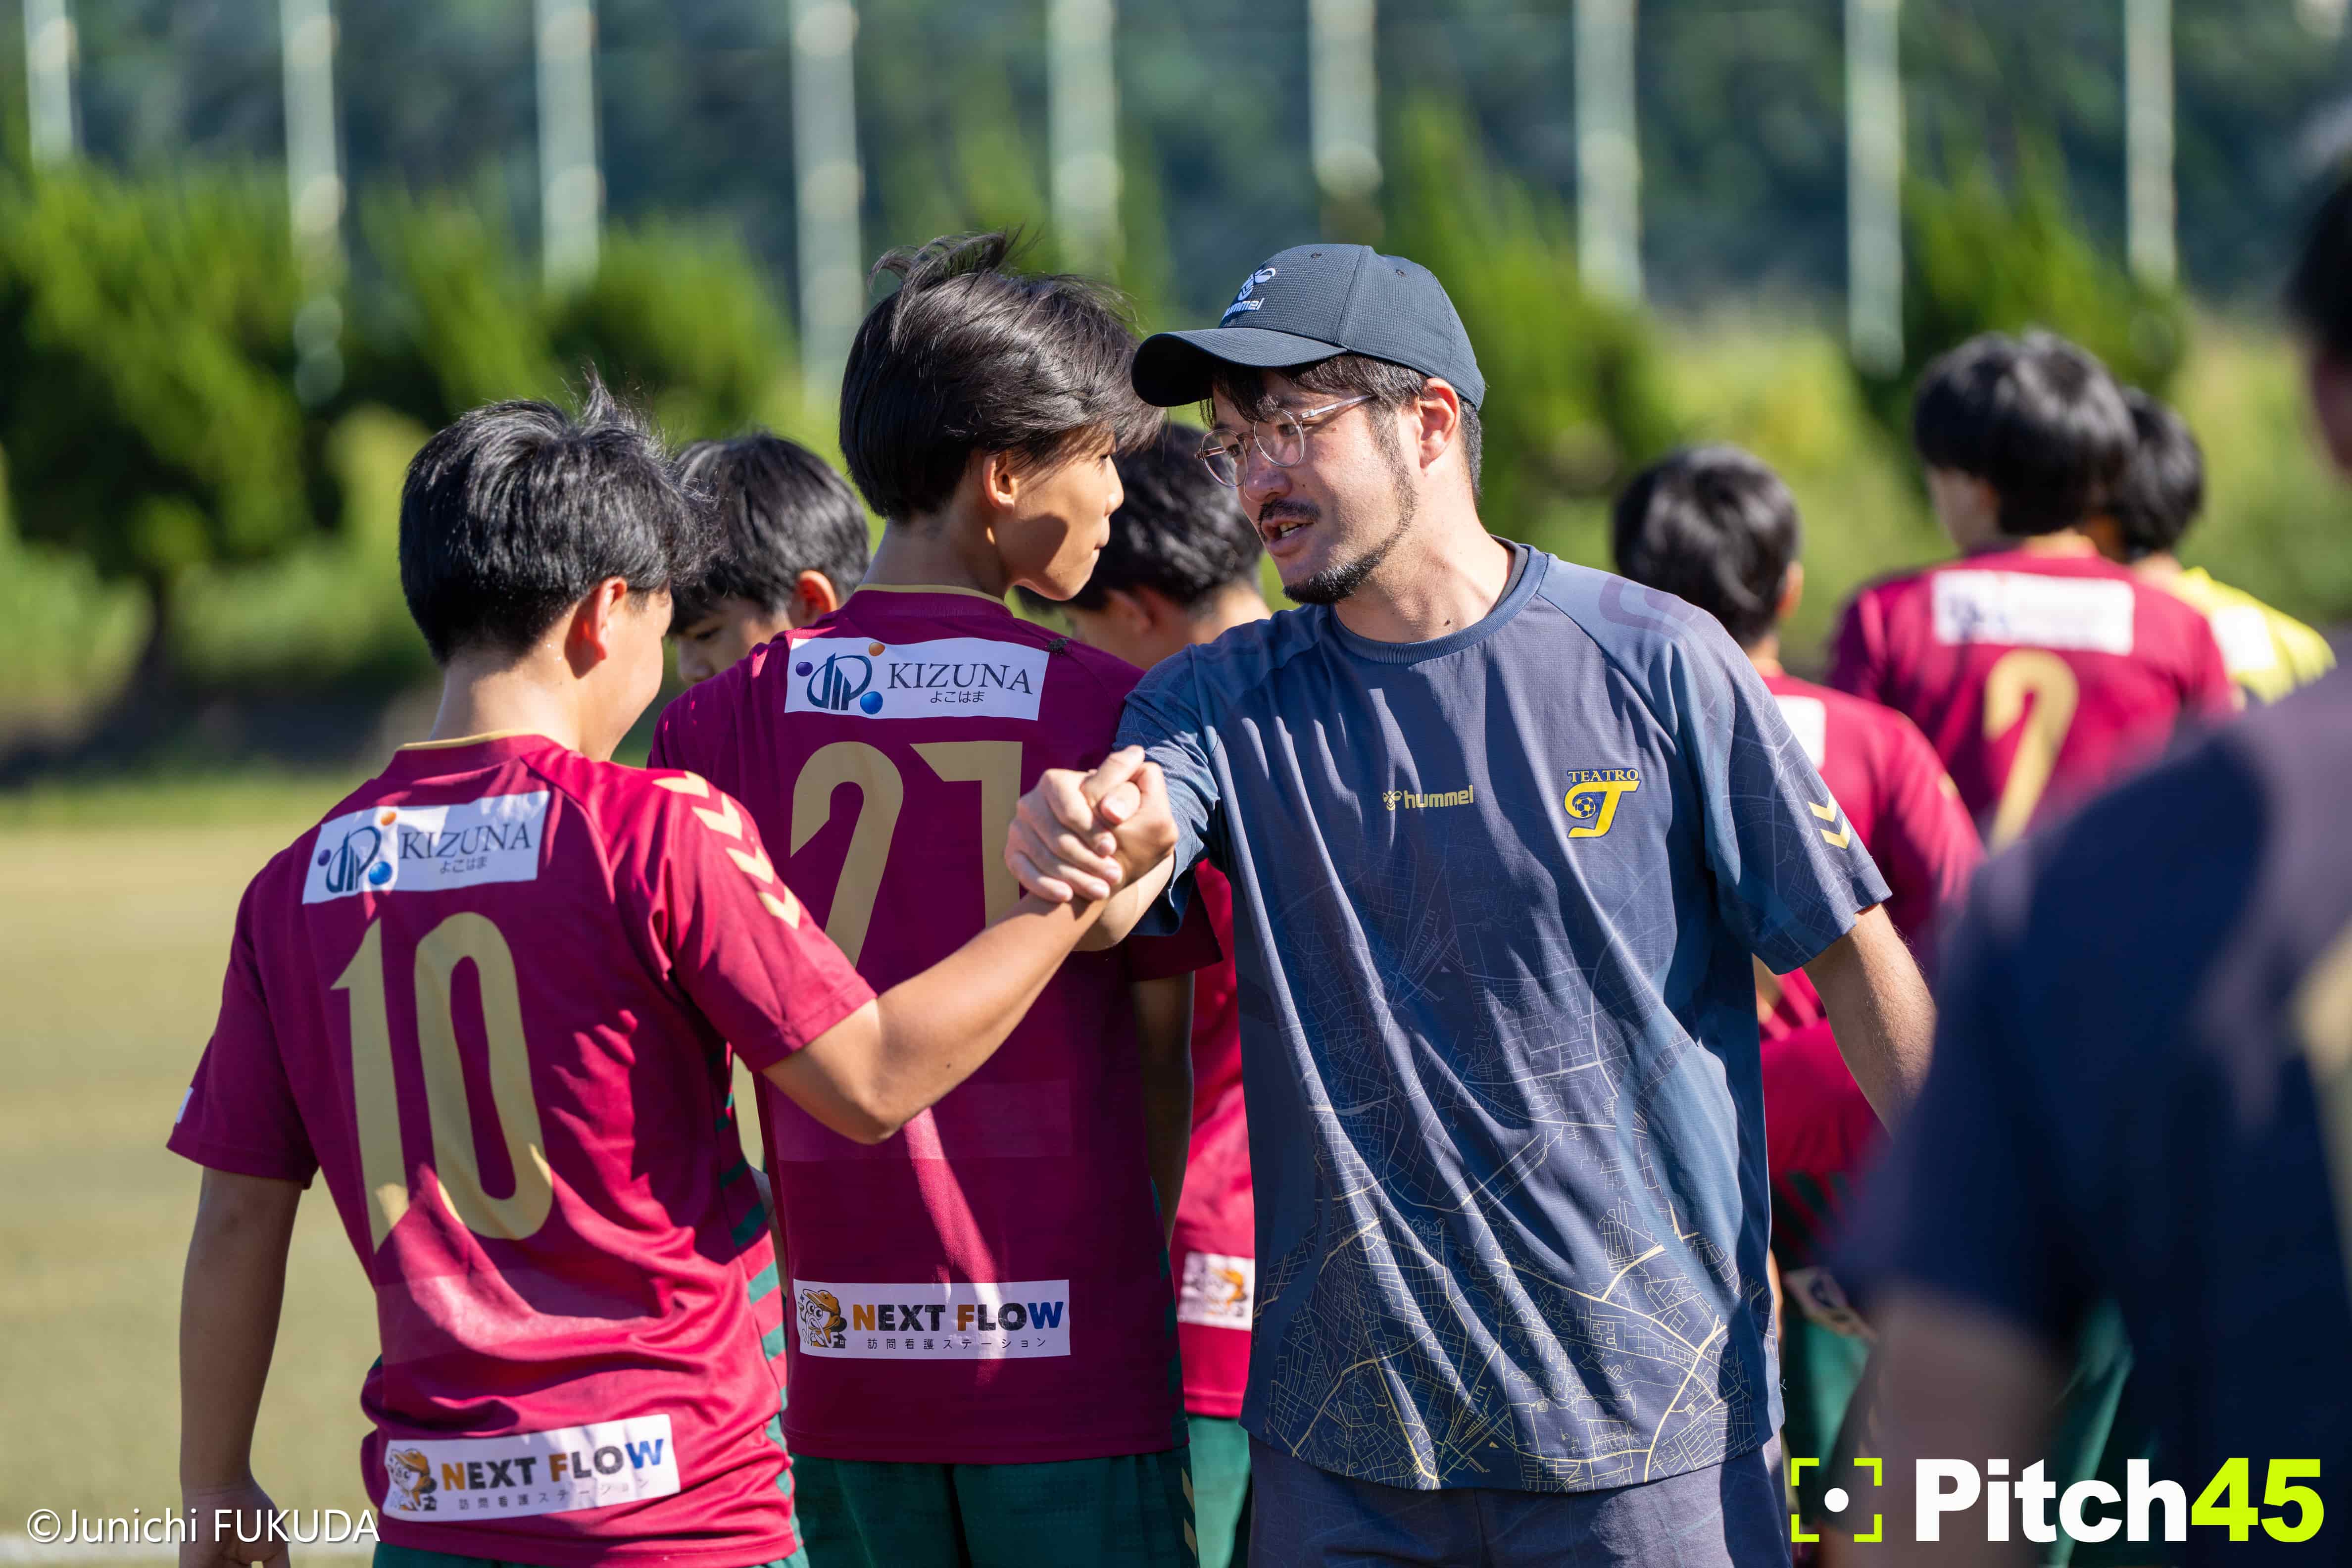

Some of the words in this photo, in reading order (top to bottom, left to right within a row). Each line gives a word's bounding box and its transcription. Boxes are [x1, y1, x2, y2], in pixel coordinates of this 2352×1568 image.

[1222, 297, 1265, 321] ummel
[886, 663, 1033, 695] KIZUNA
[930, 690, 985, 703] よこはま
[1568, 769, 1639, 782] TEATRO
[1404, 784, 1473, 809] hummel
[400, 822, 532, 860] KIZUNA
[790, 740, 1023, 968] 27
[440, 856, 488, 875] よこはま
[329, 911, 553, 1255] 10
[853, 1304, 946, 1331] NEXT
[957, 1301, 1064, 1331] FLOW
[867, 1337, 1047, 1350] 訪問看護ステーション
[441, 1457, 537, 1491] NEXT
[548, 1438, 664, 1482] FLOW
